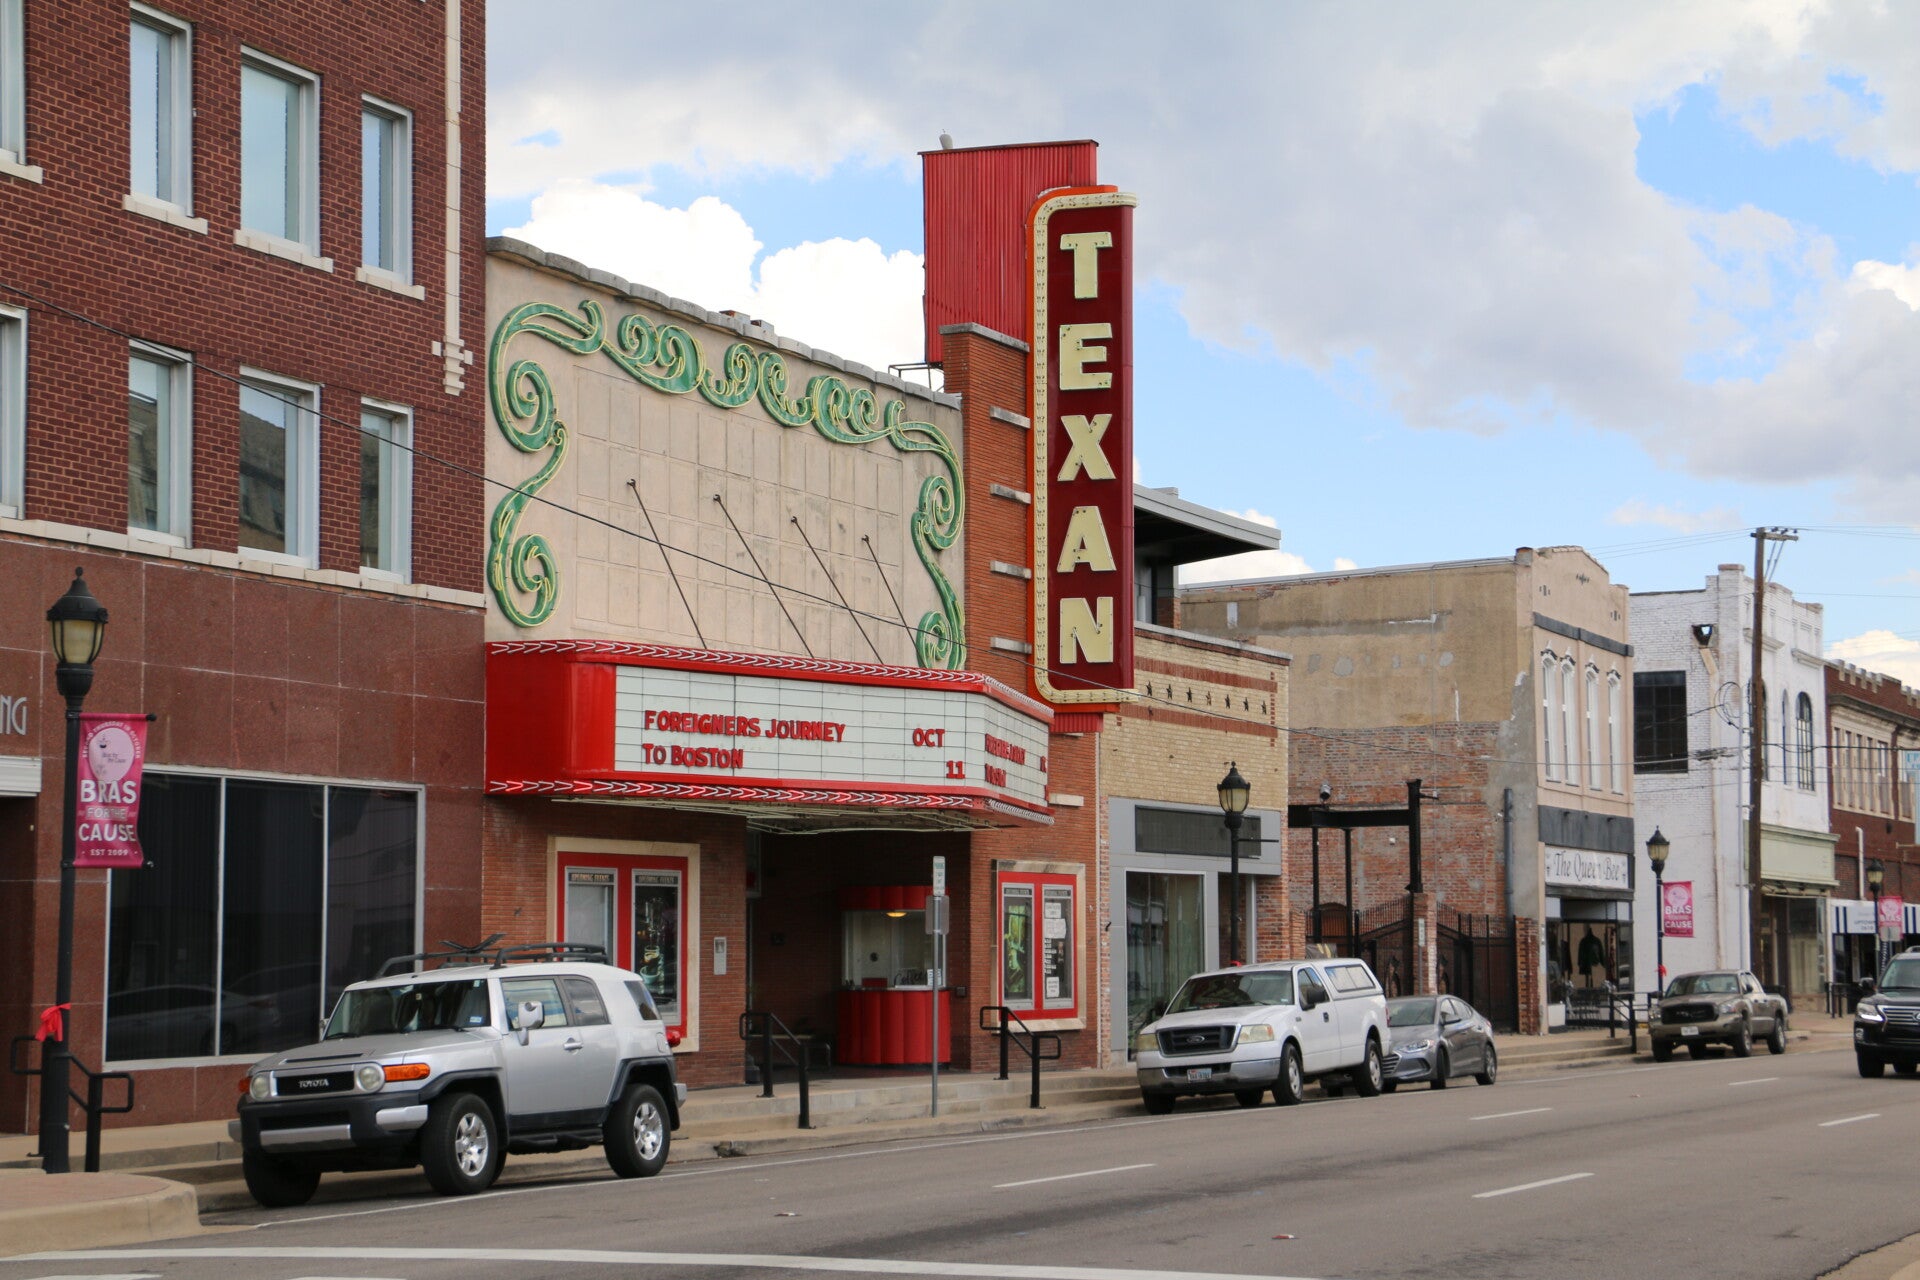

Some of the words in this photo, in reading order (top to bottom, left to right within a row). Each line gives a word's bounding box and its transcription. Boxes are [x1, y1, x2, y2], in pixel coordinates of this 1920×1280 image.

[1057, 231, 1116, 664] TEXAN
[644, 710, 761, 737] FOREIGNERS
[765, 719, 846, 742] JOURNEY
[912, 728, 945, 748] OCT
[642, 743, 667, 765] TO
[671, 745, 744, 769] BOSTON
[946, 760, 966, 779] 11
[80, 779, 137, 804] BRAS
[86, 806, 111, 819] FOR
[78, 823, 137, 842] CAUSE
[1553, 850, 1571, 877] The
[1603, 856, 1620, 881] Bee
[1665, 904, 1693, 915] BRAS
[1664, 920, 1694, 929] CAUSE
[298, 1077, 330, 1089] TOYOTA
